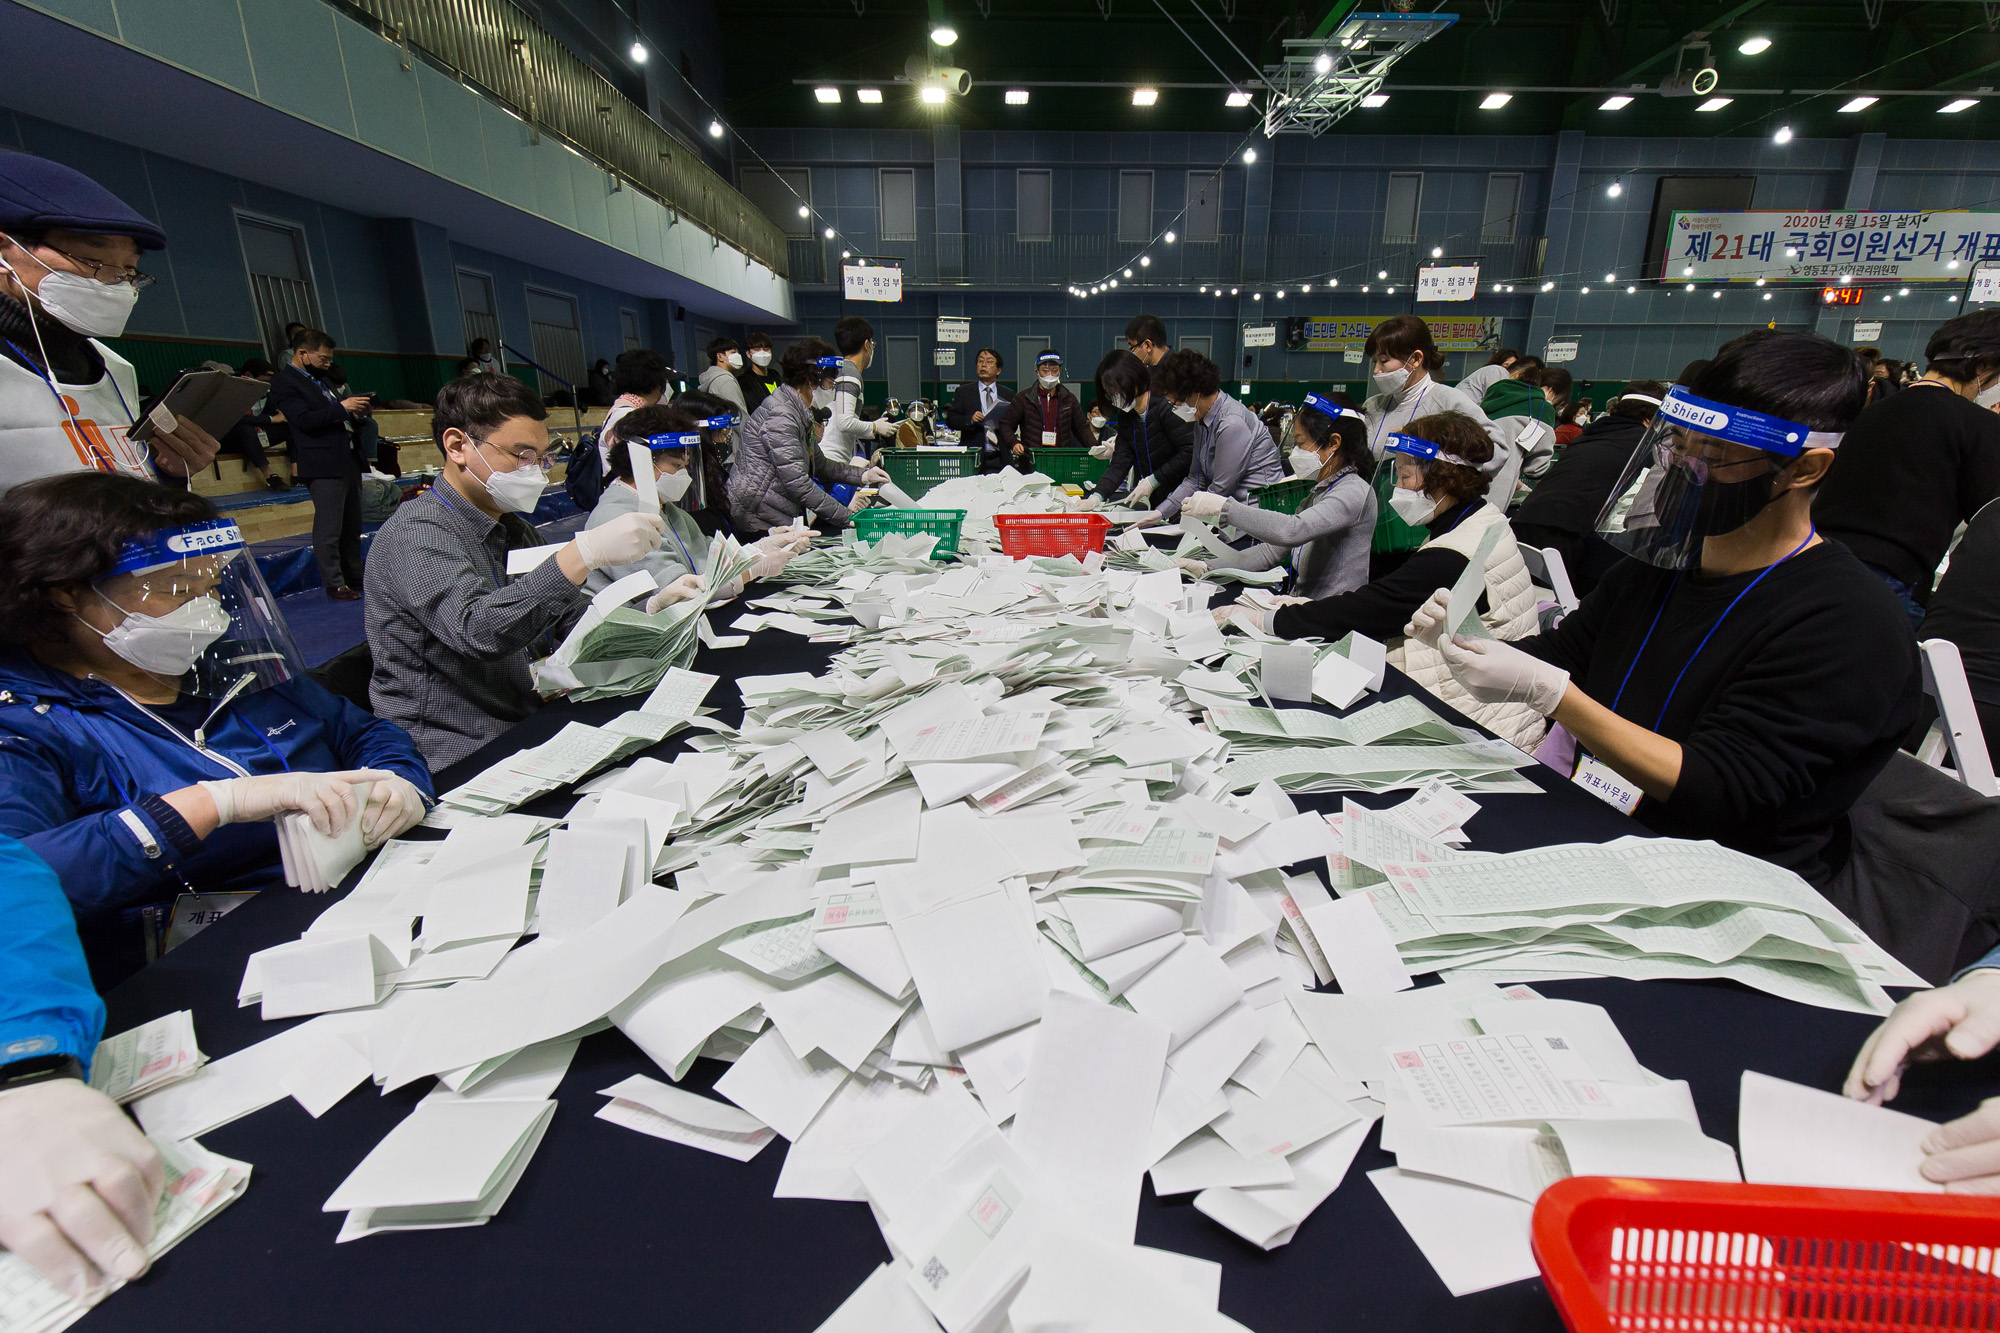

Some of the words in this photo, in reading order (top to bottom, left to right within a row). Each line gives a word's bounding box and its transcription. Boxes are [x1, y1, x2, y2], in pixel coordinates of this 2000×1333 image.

[1783, 214, 1832, 228] 2020년
[1835, 214, 1857, 229] 4월
[1862, 214, 1891, 229] 15일
[1896, 214, 1921, 229] 실시
[1684, 231, 1775, 262] 제21대
[1784, 231, 1946, 262] 국회의원선거
[1304, 322, 1338, 339] 배드민턴
[1339, 322, 1372, 339] 고수되는
[1427, 322, 1450, 339] 드민턴
[1452, 322, 1484, 339] 필라테스
[1672, 403, 1716, 426] Shield
[182, 534, 223, 549] Face
[1583, 772, 1631, 805] 개표사무원
[188, 911, 224, 924] 개표
